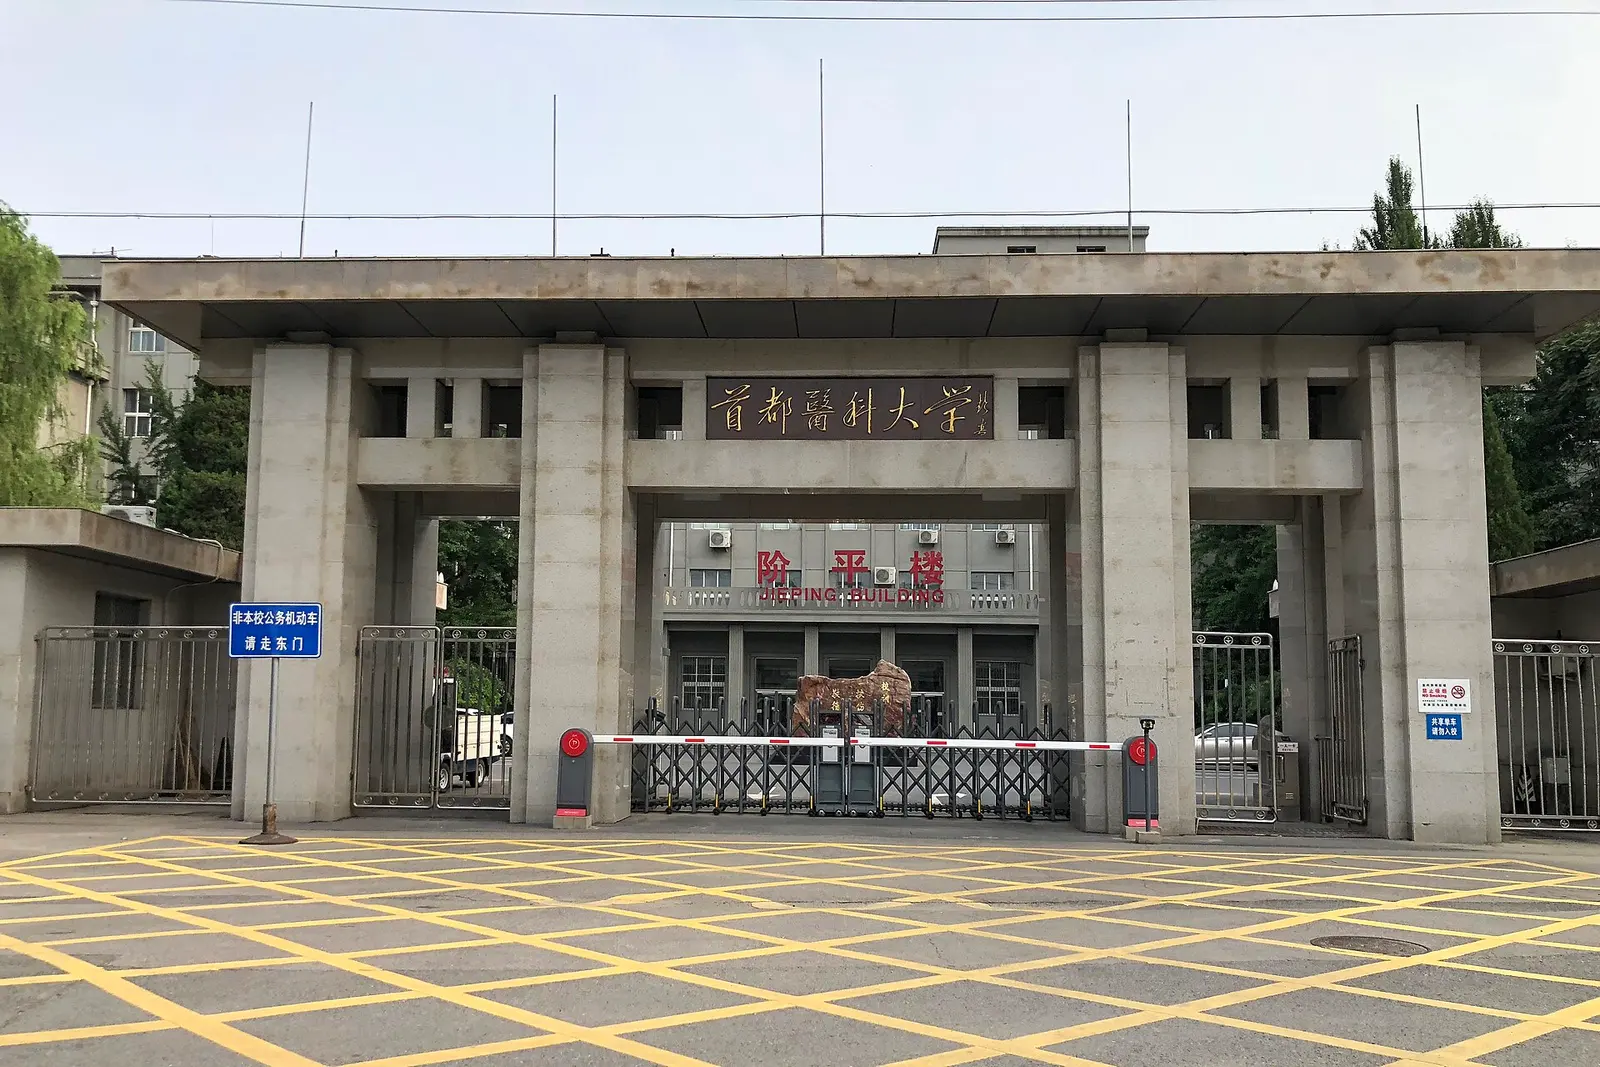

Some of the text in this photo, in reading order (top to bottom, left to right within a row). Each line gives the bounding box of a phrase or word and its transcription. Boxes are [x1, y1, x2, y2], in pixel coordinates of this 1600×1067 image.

[757, 550, 944, 584] 阶平楼
[760, 587, 944, 603] JIEPING BUILDING
[232, 610, 318, 625] 非本校公务机动车
[244, 635, 303, 651] 请走东门
[1431, 717, 1457, 726] 共享单车
[1431, 727, 1458, 736] 请勿入校
